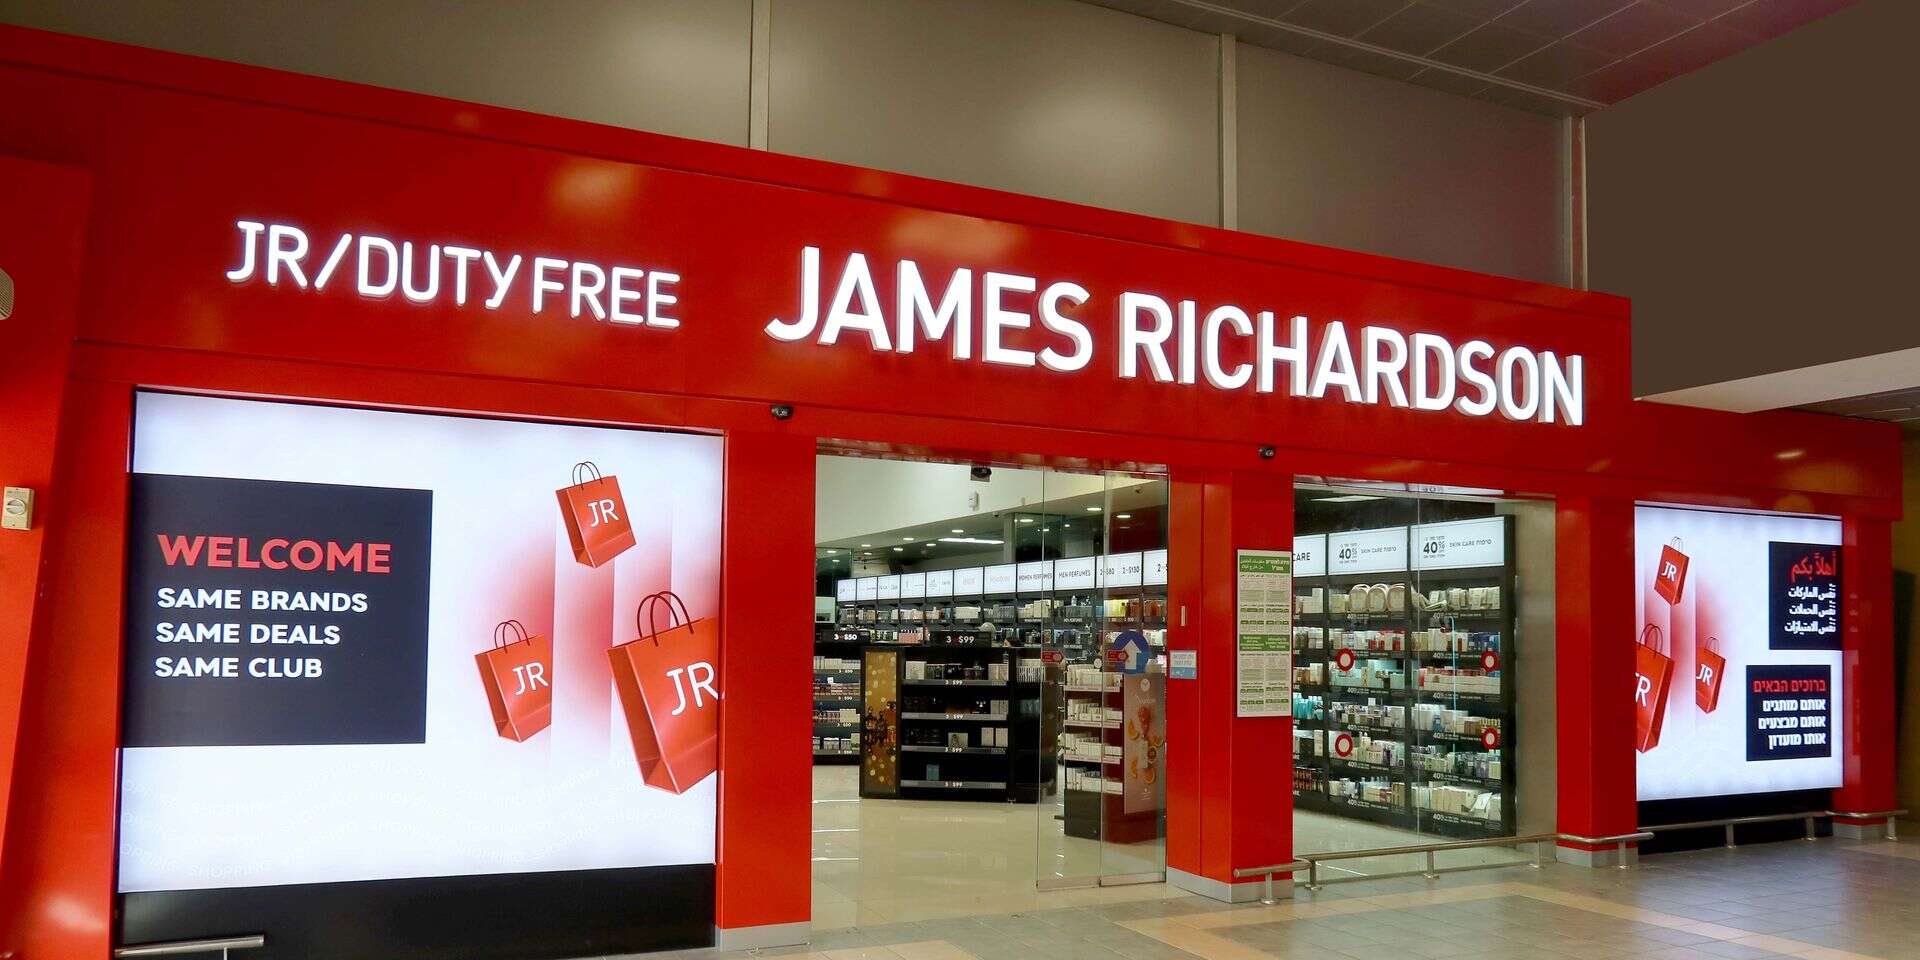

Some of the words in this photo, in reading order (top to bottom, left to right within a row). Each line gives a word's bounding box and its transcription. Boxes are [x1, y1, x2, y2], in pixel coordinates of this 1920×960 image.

[532, 257, 681, 329] FREE
[764, 246, 1093, 372] JAMES
[1118, 291, 1584, 427] RICHARDSON
[587, 498, 619, 528] JR
[157, 534, 392, 574] WELCOME
[1292, 552, 1311, 562] CARE
[1068, 569, 1091, 578] PERFUMES
[1661, 560, 1678, 582] JR
[1790, 555, 1813, 583] بكم
[157, 587, 241, 610] SAME
[251, 590, 368, 613] BRANDS
[155, 622, 241, 644] SAME
[250, 623, 341, 645] DEALS
[154, 656, 240, 678] SAME
[248, 657, 323, 678] CLUB
[1696, 663, 1713, 687] JR
[512, 662, 549, 696] JR
[666, 660, 717, 716] JR
[1635, 672, 1652, 708] R
[1753, 680, 1789, 694] הבאים
[1790, 679, 1827, 693] ברוכים
[1799, 699, 1827, 711] אותם
[1799, 716, 1827, 728] אותם
[1768, 734, 1802, 750] מועדון
[1803, 733, 1827, 745] אותו
